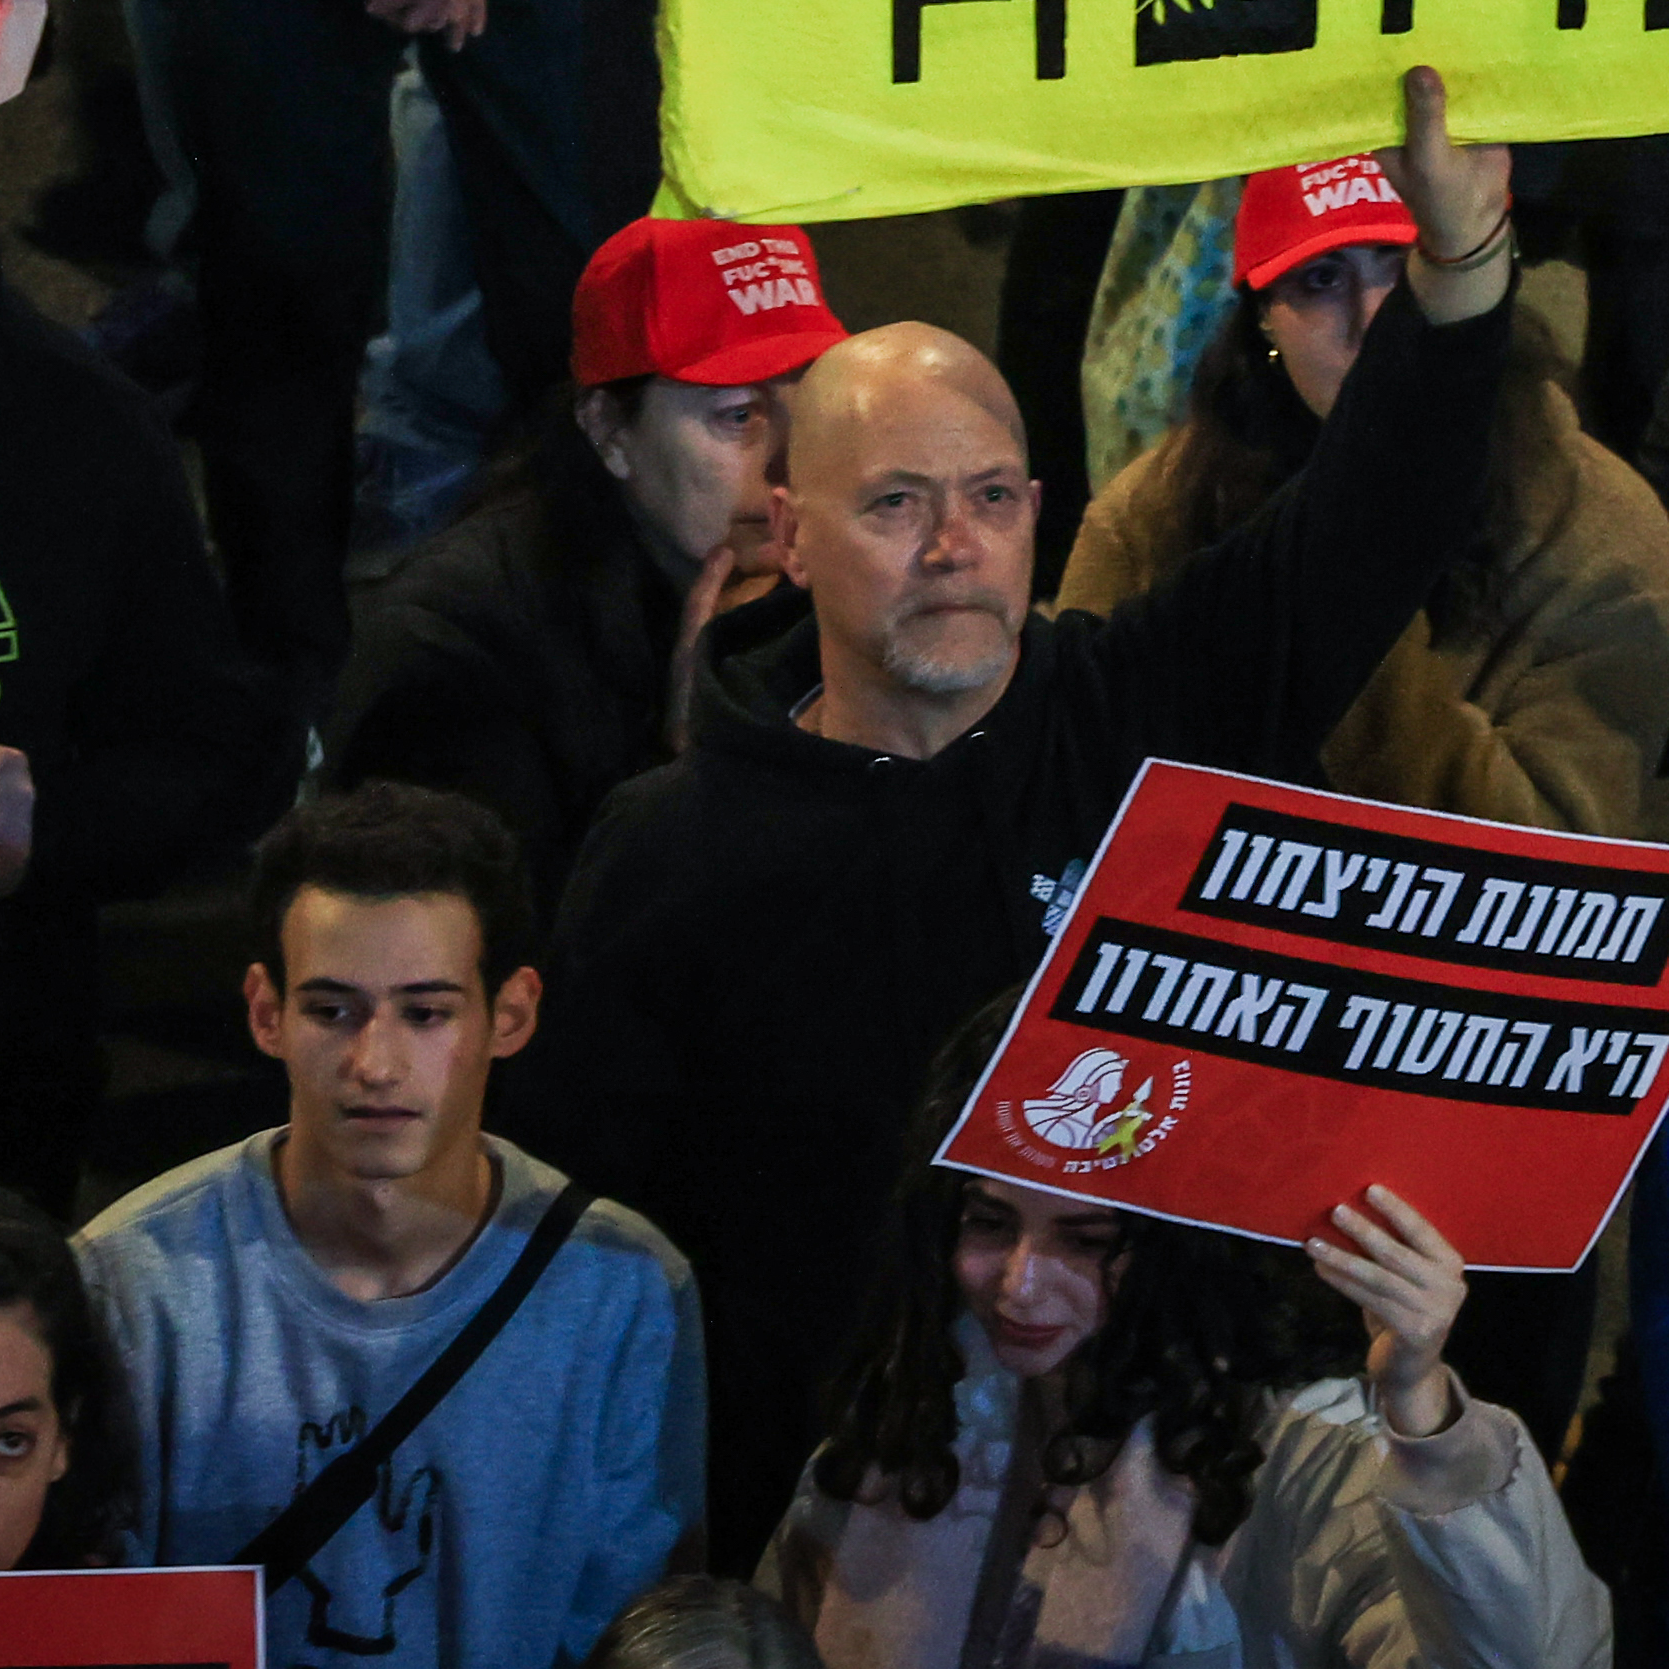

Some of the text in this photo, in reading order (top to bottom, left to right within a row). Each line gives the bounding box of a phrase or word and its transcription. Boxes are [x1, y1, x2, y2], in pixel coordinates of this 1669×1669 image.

[1199, 827, 1466, 938] הניצחון
[1457, 875, 1667, 965] תמונת
[1074, 940, 1332, 1054] האחרון
[1335, 995, 1550, 1091] החטוף
